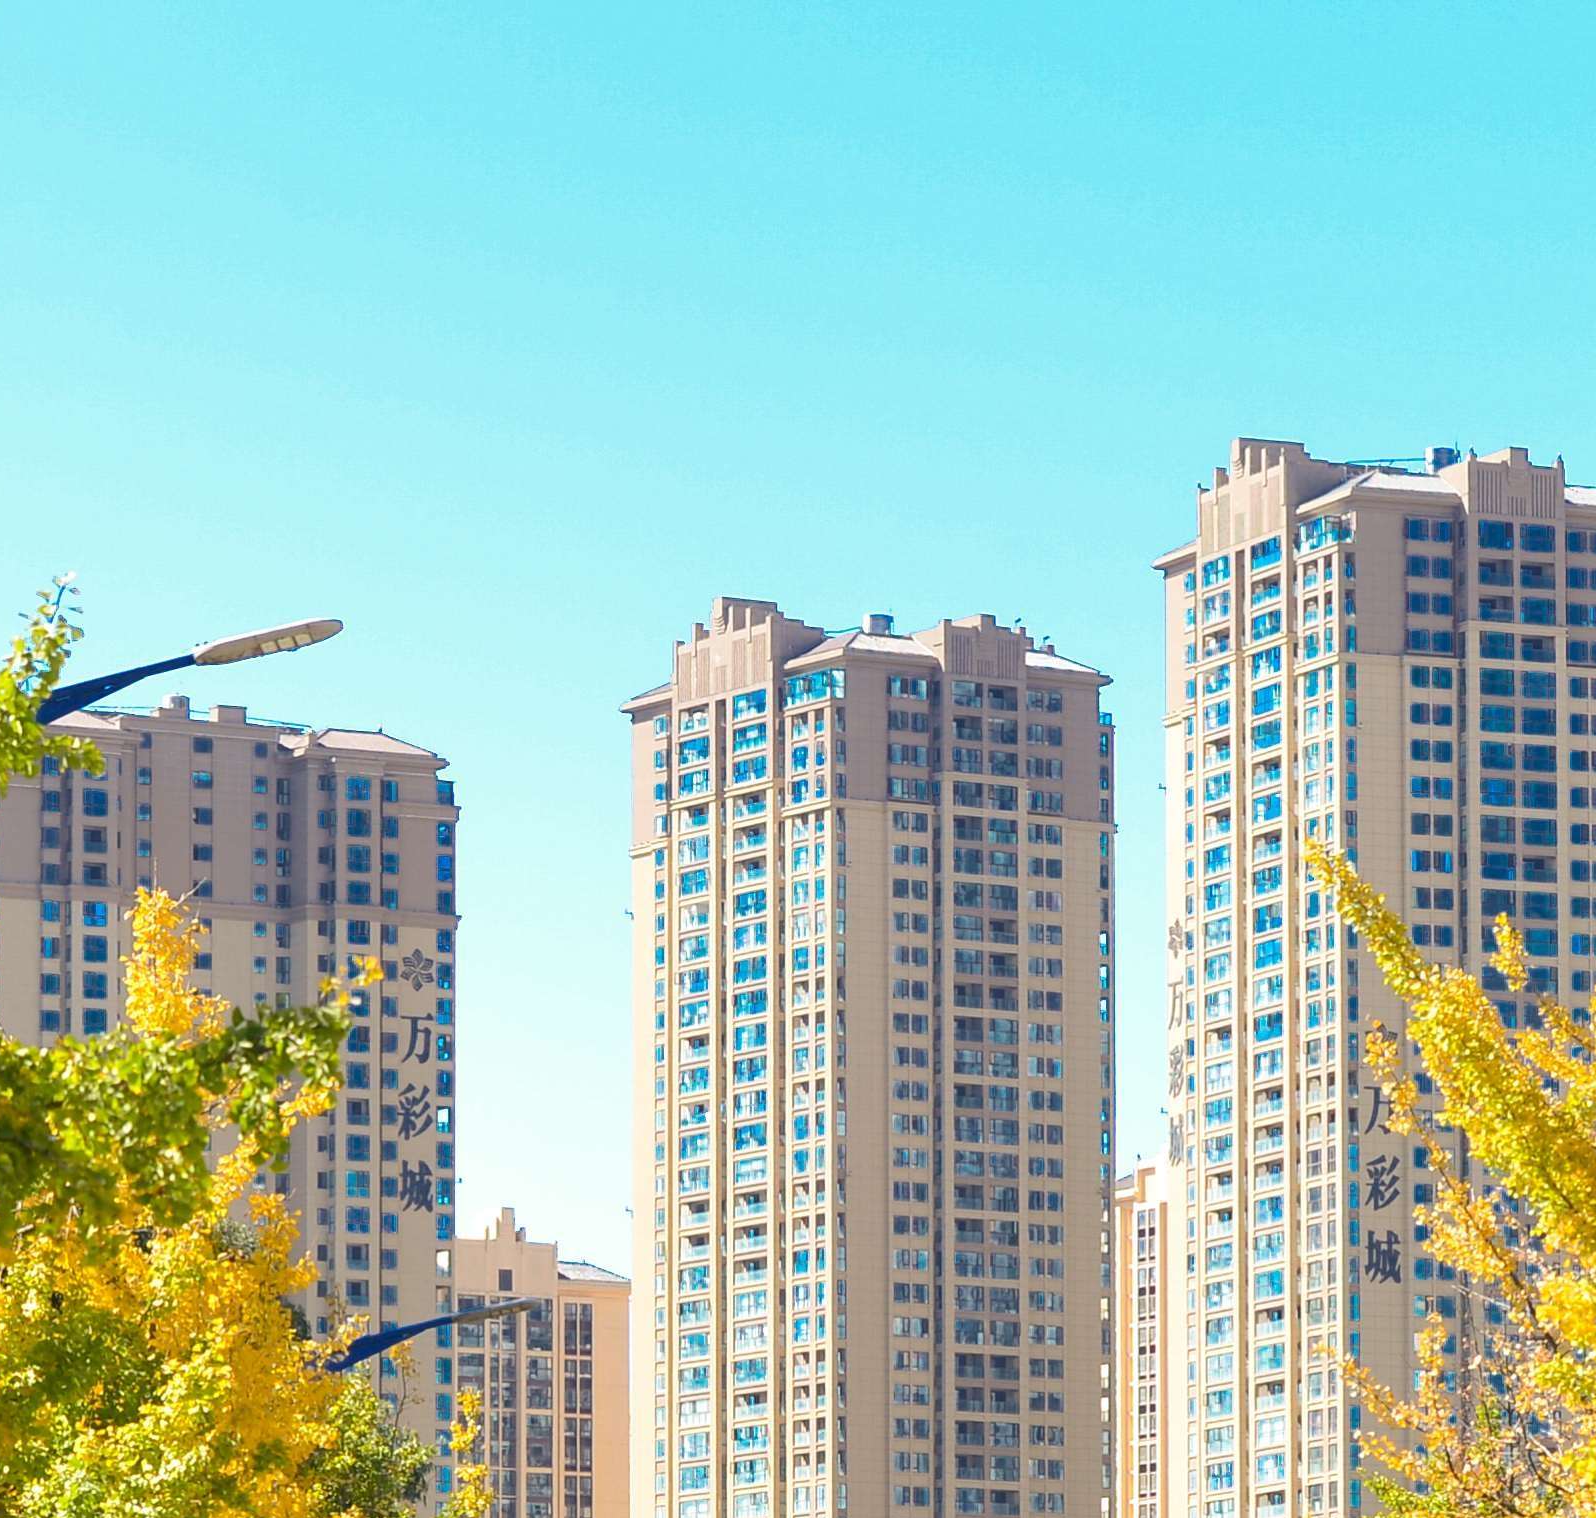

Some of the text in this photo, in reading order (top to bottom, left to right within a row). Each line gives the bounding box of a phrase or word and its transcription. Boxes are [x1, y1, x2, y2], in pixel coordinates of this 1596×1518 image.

[397, 1012, 434, 1212] 万彩城
[1168, 975, 1184, 1167] 万彩城
